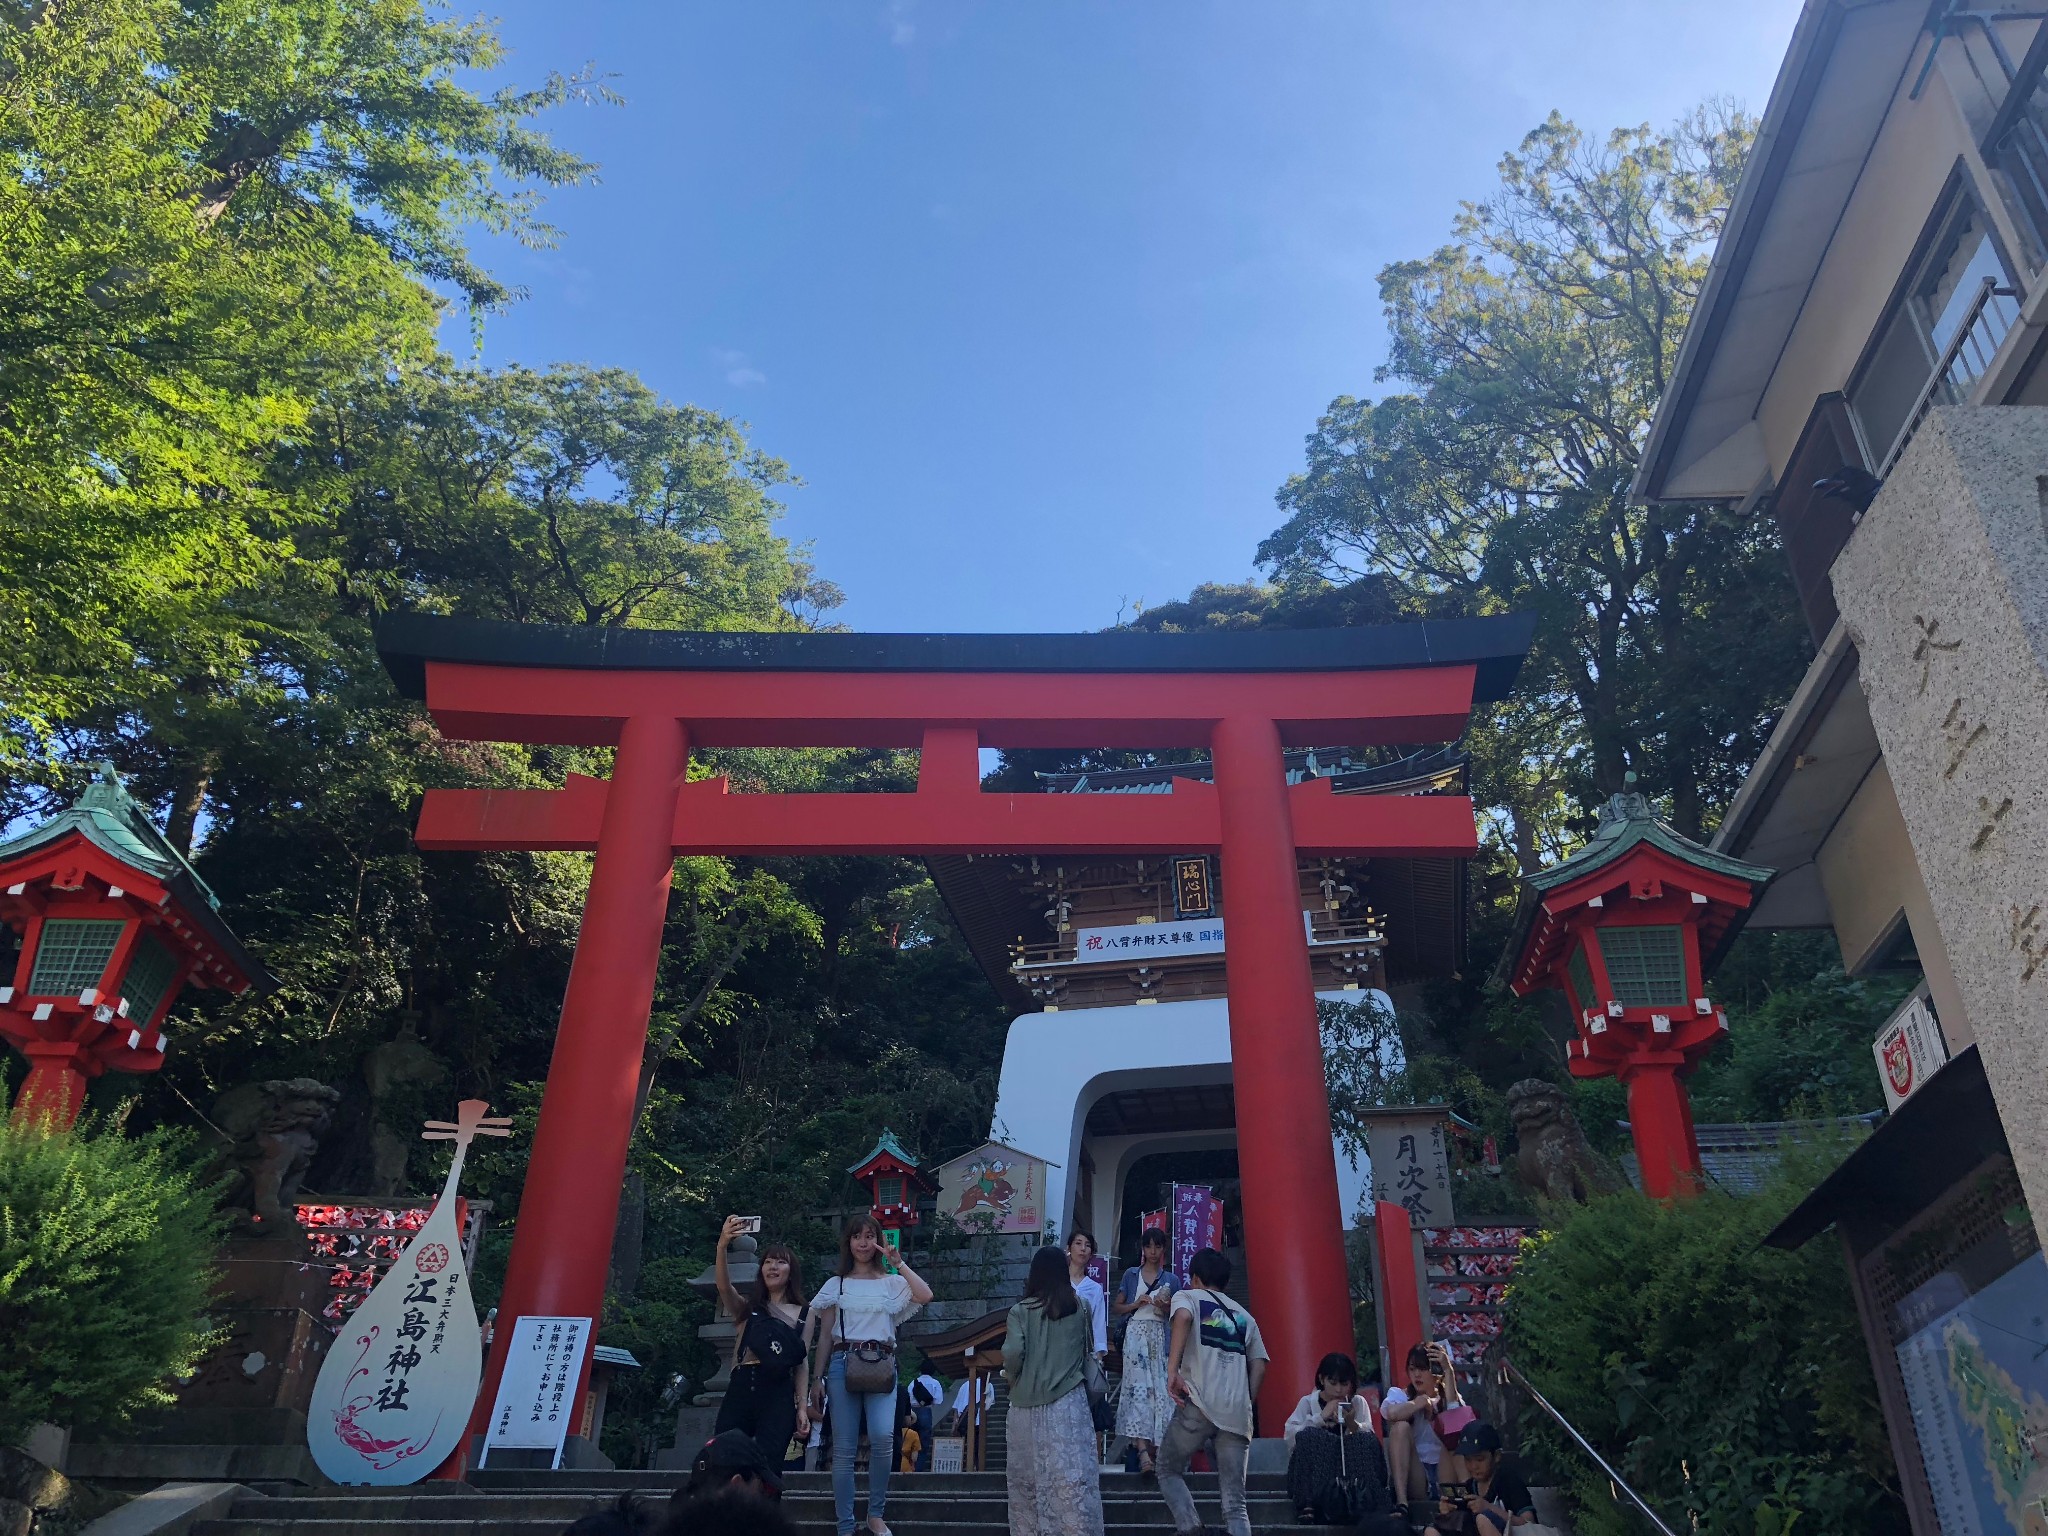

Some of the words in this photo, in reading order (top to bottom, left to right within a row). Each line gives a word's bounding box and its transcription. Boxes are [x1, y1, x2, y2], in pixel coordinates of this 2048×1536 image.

[1182, 863, 1202, 908] 瑞心門
[1086, 935, 1104, 951] 祝
[1106, 930, 1196, 948] 八臂弁財天尊像
[1395, 1134, 1432, 1226] 月次祭
[373, 1273, 438, 1412] 江島神社
[429, 1273, 460, 1354] 日本三大弁財天
[532, 1324, 547, 1351] 下さい
[530, 1324, 562, 1421] 社務所にてお申し込み
[548, 1324, 579, 1421] 御祈祷の方は階段上の
[498, 1405, 512, 1435] 江島神社
